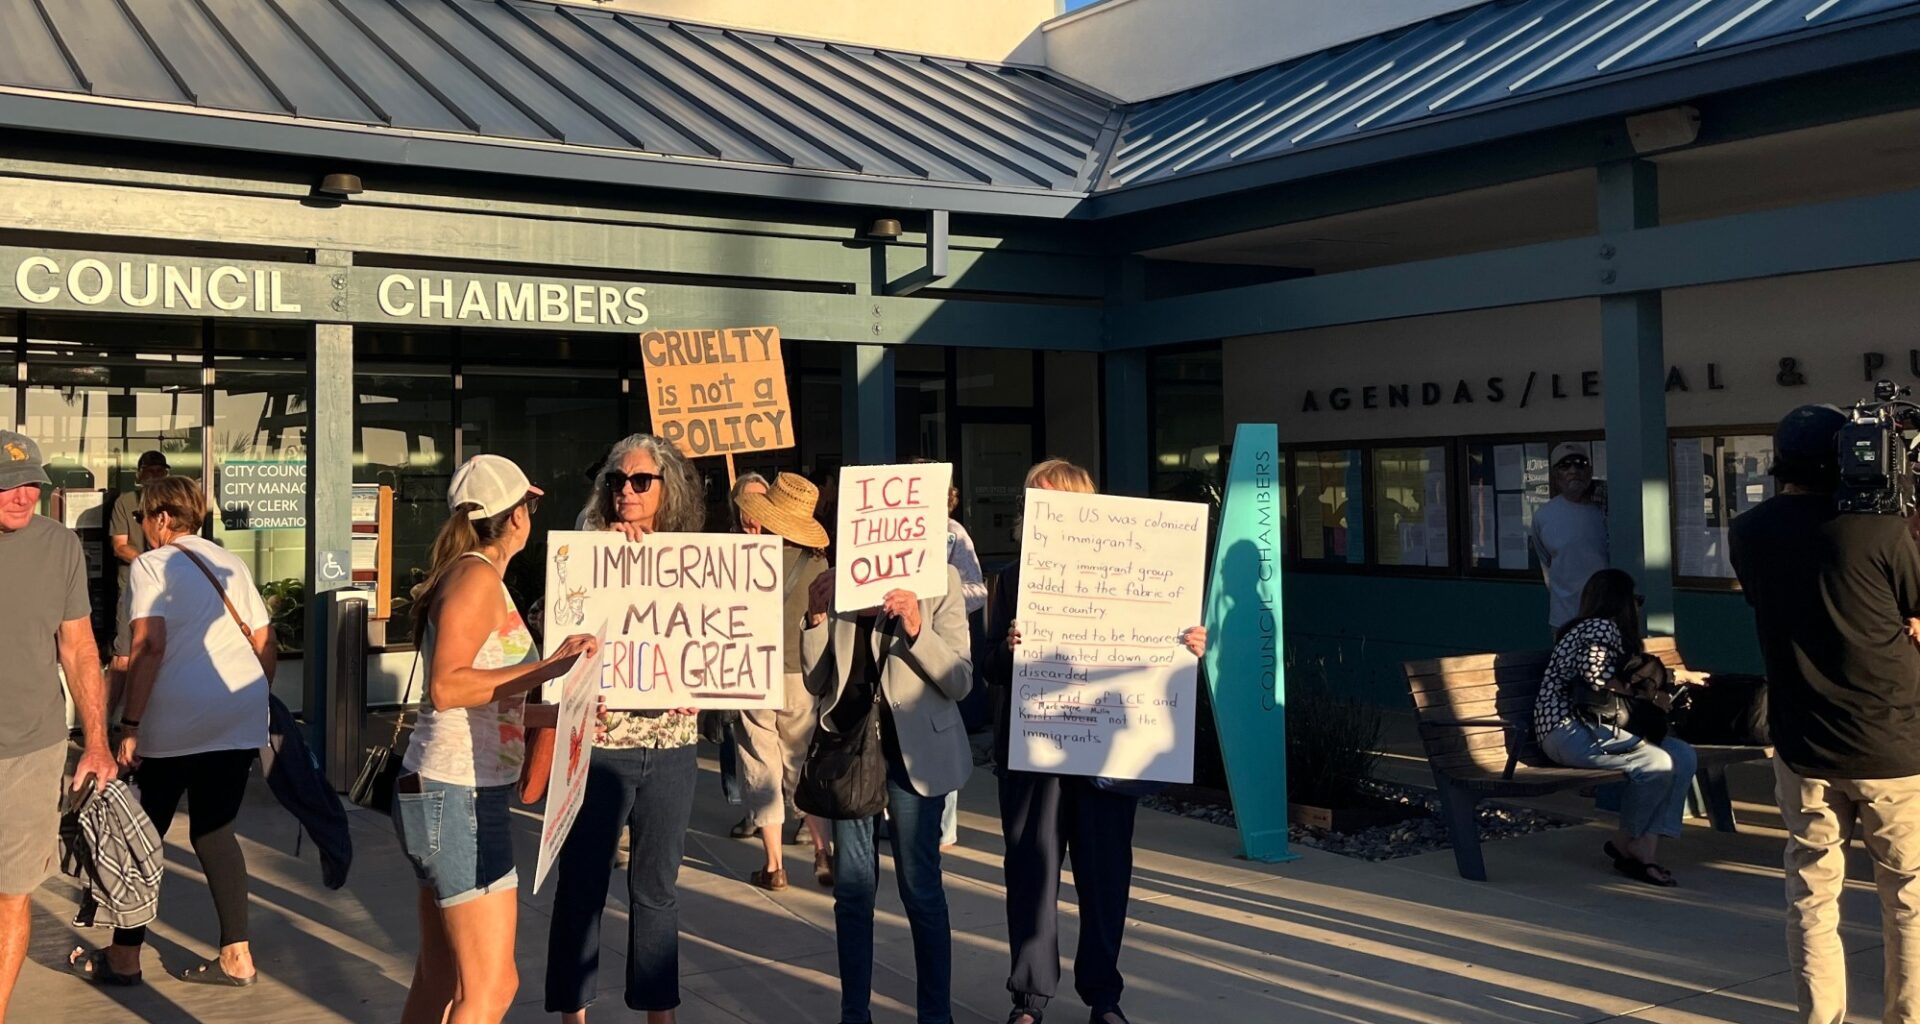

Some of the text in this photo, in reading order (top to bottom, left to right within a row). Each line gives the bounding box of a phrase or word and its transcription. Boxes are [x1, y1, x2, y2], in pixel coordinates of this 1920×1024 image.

[15, 256, 650, 325] COUNCIL CHAMBERS
[642, 328, 774, 367] CRUELTY
[656, 372, 774, 406] is not a
[1302, 363, 1724, 412] AGENDAS/LEAL
[1776, 356, 1808, 387] &
[662, 409, 786, 455] POLICY
[225, 465, 255, 477] CITY
[225, 482, 255, 495] CITY
[855, 476, 922, 511] ICE
[225, 499, 298, 512] CITY CLERK
[1034, 501, 1199, 532] The US was colonized
[1256, 450, 1274, 582] CHAMBERS
[851, 516, 926, 545] THUGS
[1033, 525, 1048, 548] by
[593, 543, 778, 592] IMMIGRANTS
[850, 549, 926, 584] OUT!
[1027, 552, 1174, 582] Every immigrant group
[1027, 576, 1185, 599] added to the fabric of
[622, 600, 753, 640] MAKE
[1028, 601, 1051, 613] our
[1022, 621, 1054, 640] They
[1061, 628, 1087, 641] need
[1092, 629, 1106, 642] to
[1111, 628, 1125, 642] be
[550, 641, 673, 693] ERICA
[681, 640, 777, 690] GREAT
[1023, 645, 1175, 663] not hunted down and
[1258, 593, 1276, 712] COUNCIL
[1019, 664, 1088, 682] discarded
[1020, 684, 1178, 707] Get rid of ICE and
[1108, 715, 1128, 725] not
[1138, 714, 1157, 726] the
[1022, 729, 1102, 750] immigrants
